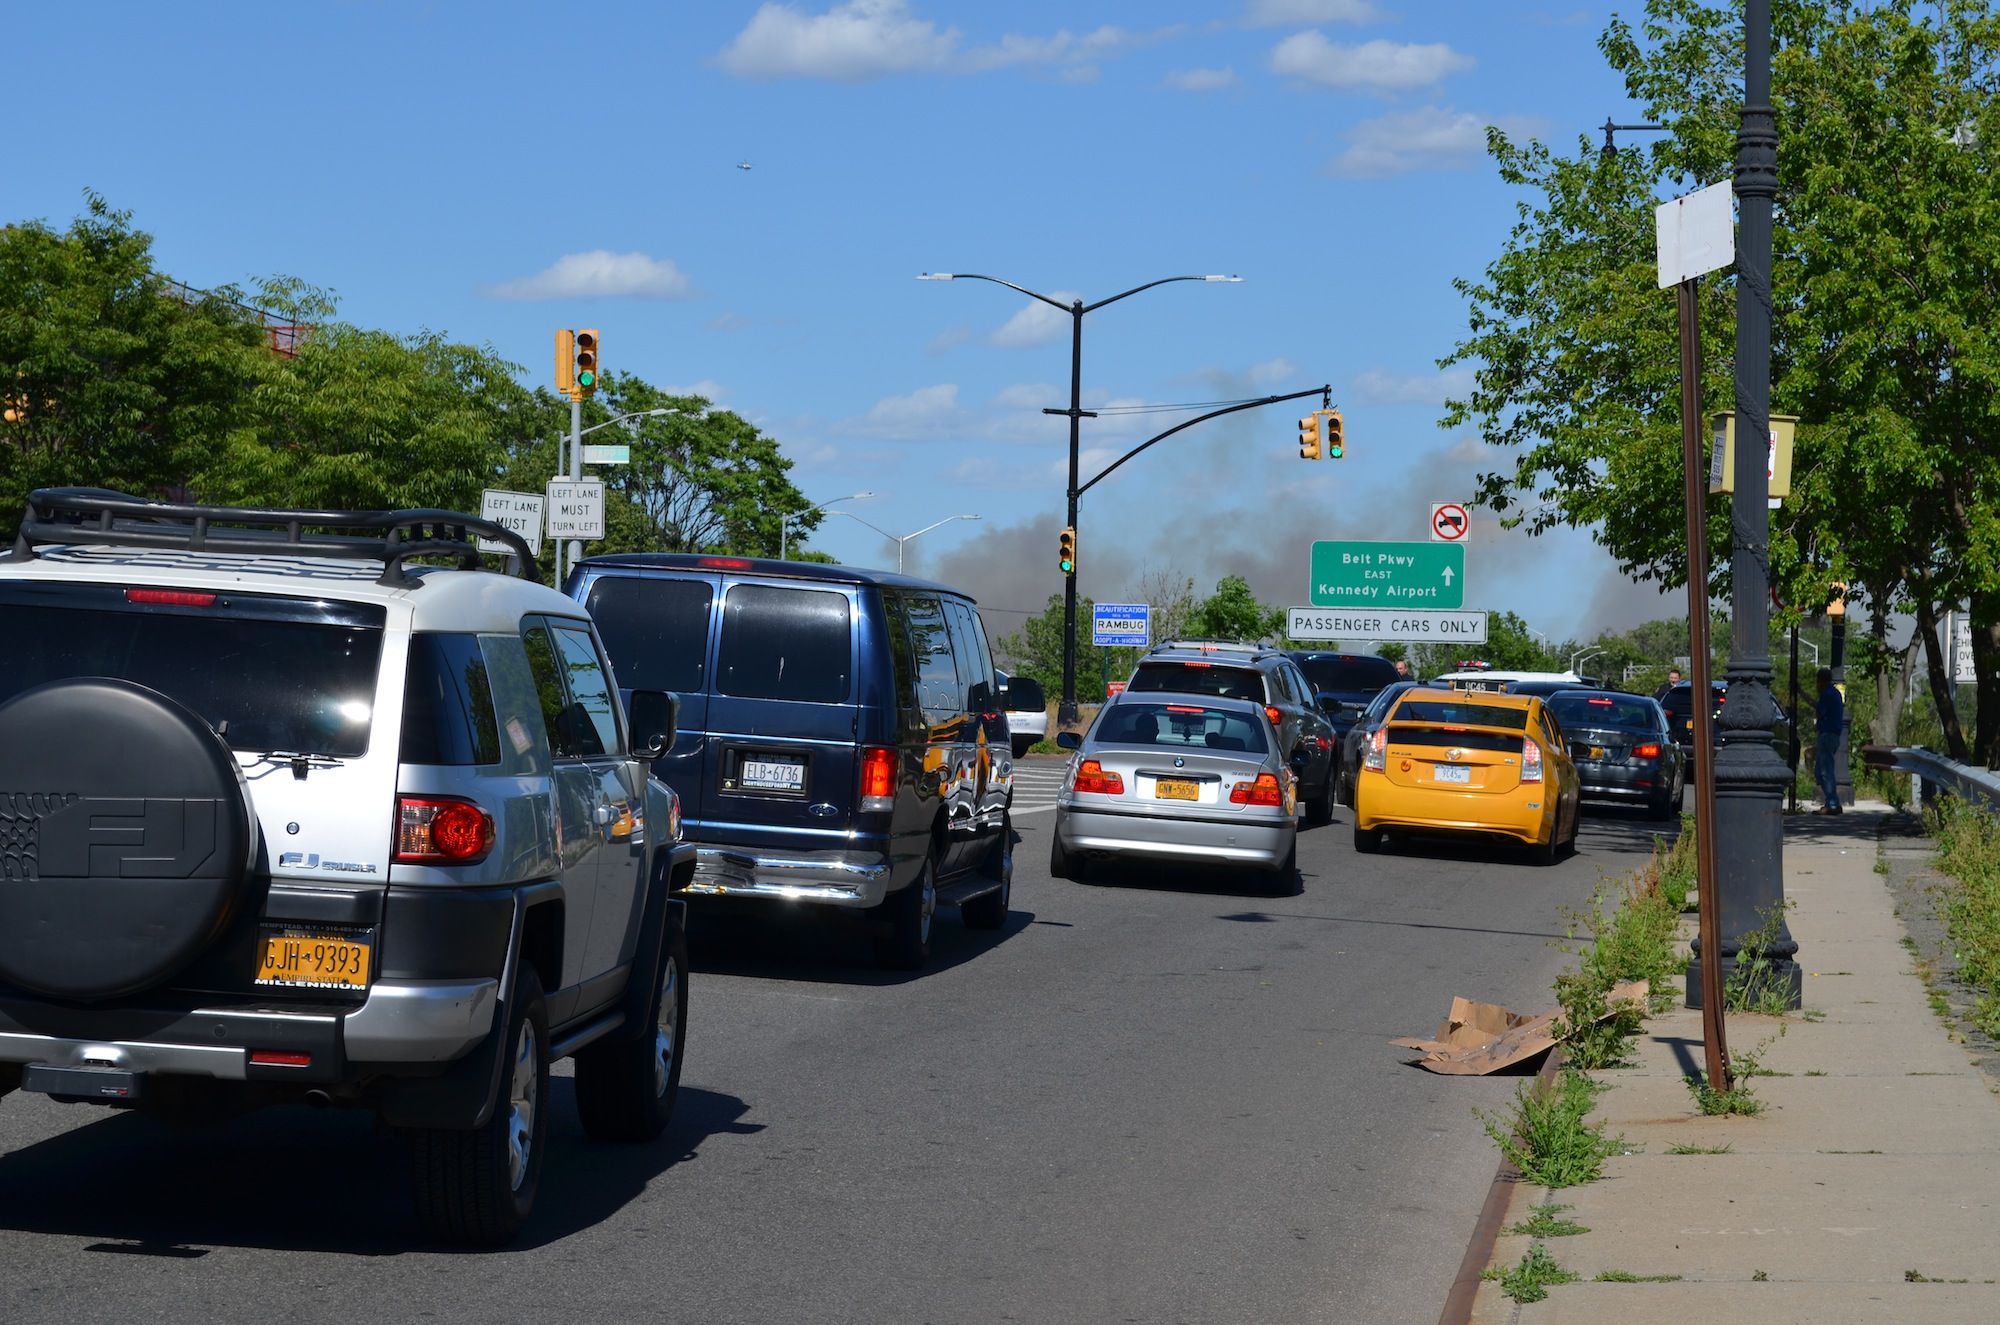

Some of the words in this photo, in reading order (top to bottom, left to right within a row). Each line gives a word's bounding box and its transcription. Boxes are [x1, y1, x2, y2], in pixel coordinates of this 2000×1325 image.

[552, 489, 572, 498] LEFT
[577, 489, 599, 498] LANE
[487, 498, 511, 511] LEFT
[514, 501, 539, 513] LANE
[561, 504, 590, 516] MUST
[496, 516, 527, 531] MUST
[552, 522, 575, 531] TURN
[578, 522, 599, 531] LEFT
[1342, 553, 1371, 564] Belt
[1378, 554, 1415, 567] Pkwy
[1364, 570, 1392, 579] EAST
[1319, 584, 1378, 598] Kennedy
[1386, 585, 1437, 598] Airport
[1098, 620, 1144, 629] RAMBUG
[1295, 617, 1381, 631] PASSENGER
[1391, 619, 1430, 632] CARS
[1440, 620, 1479, 633] ONLY
[1960, 651, 1975, 661] OVE
[281, 973, 312, 982] EMPIRE
[254, 979, 366, 990] MILLENNIUM
